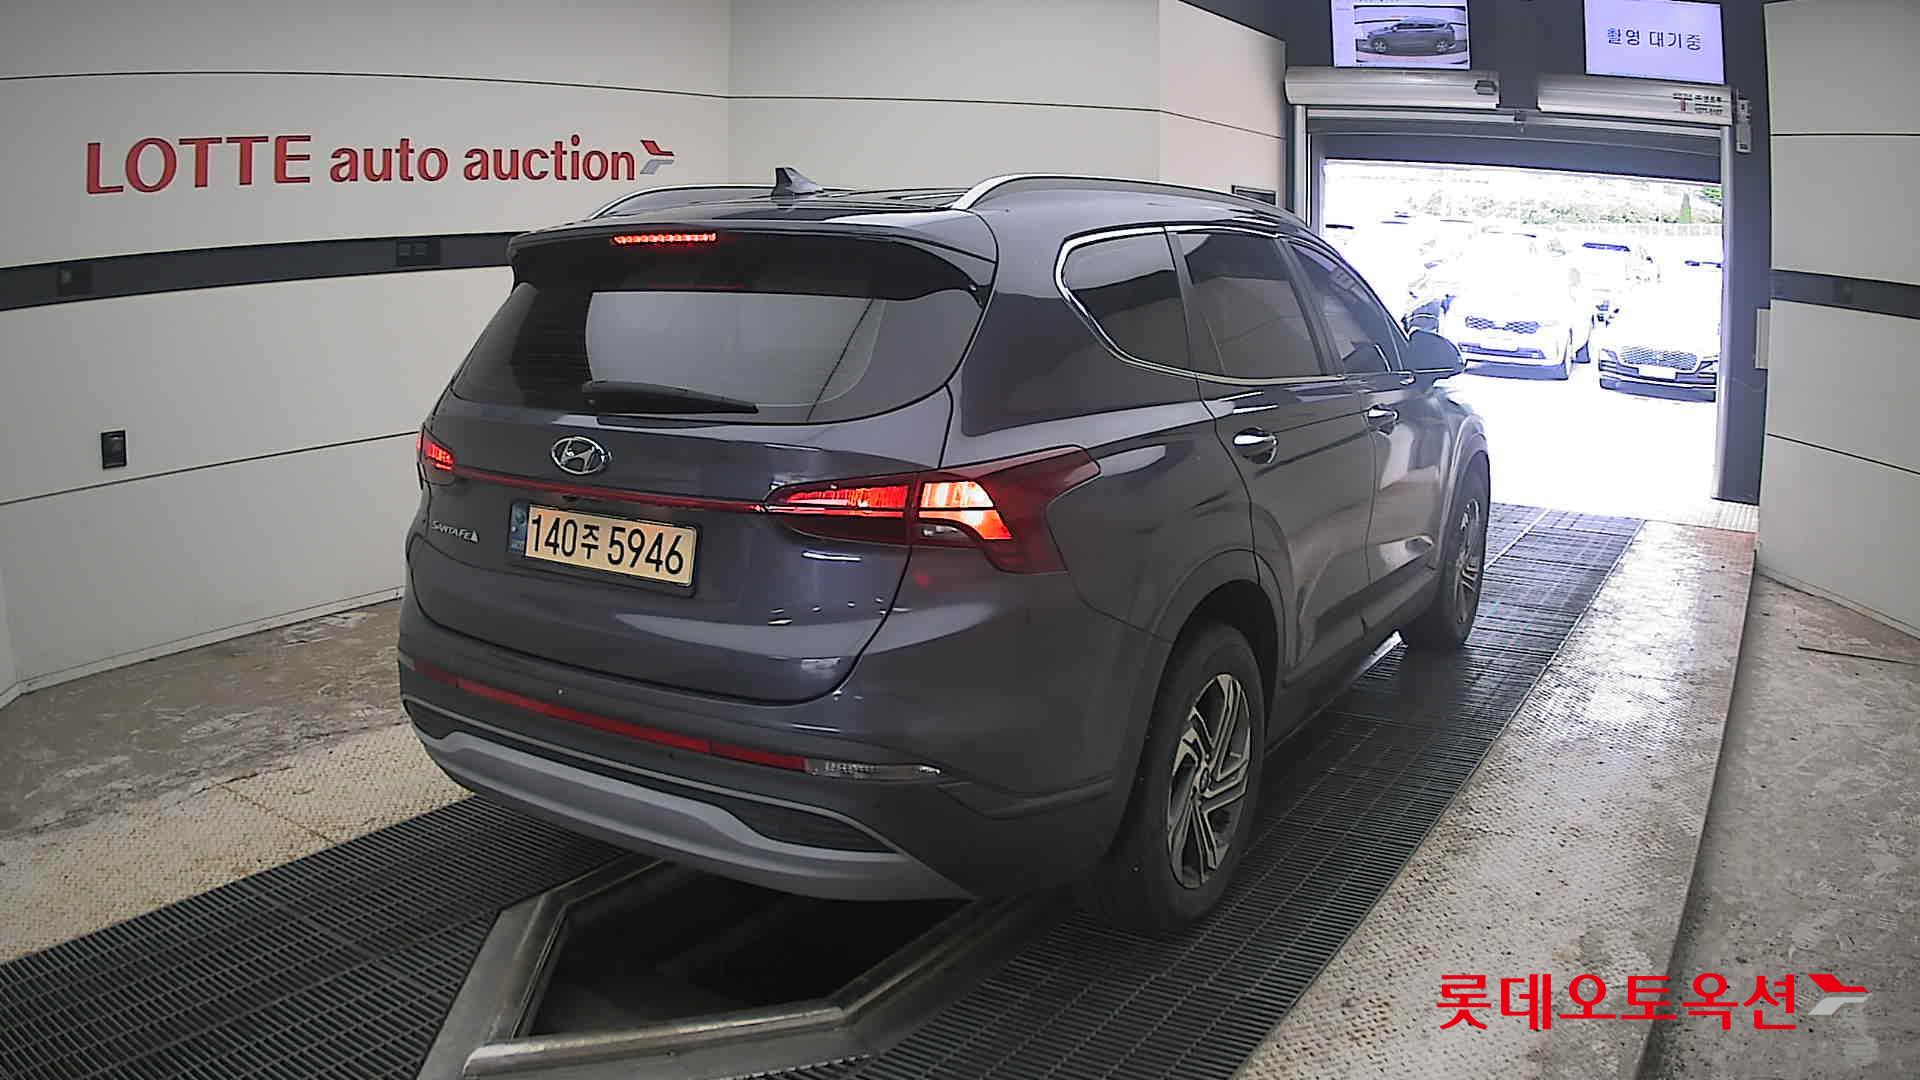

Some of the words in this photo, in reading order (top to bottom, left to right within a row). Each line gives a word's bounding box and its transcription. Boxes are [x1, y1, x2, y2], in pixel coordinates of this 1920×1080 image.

[86, 135, 311, 194] LOTTE
[329, 138, 449, 182] auto
[463, 134, 635, 181] auction
[607, 525, 684, 576] 5946
